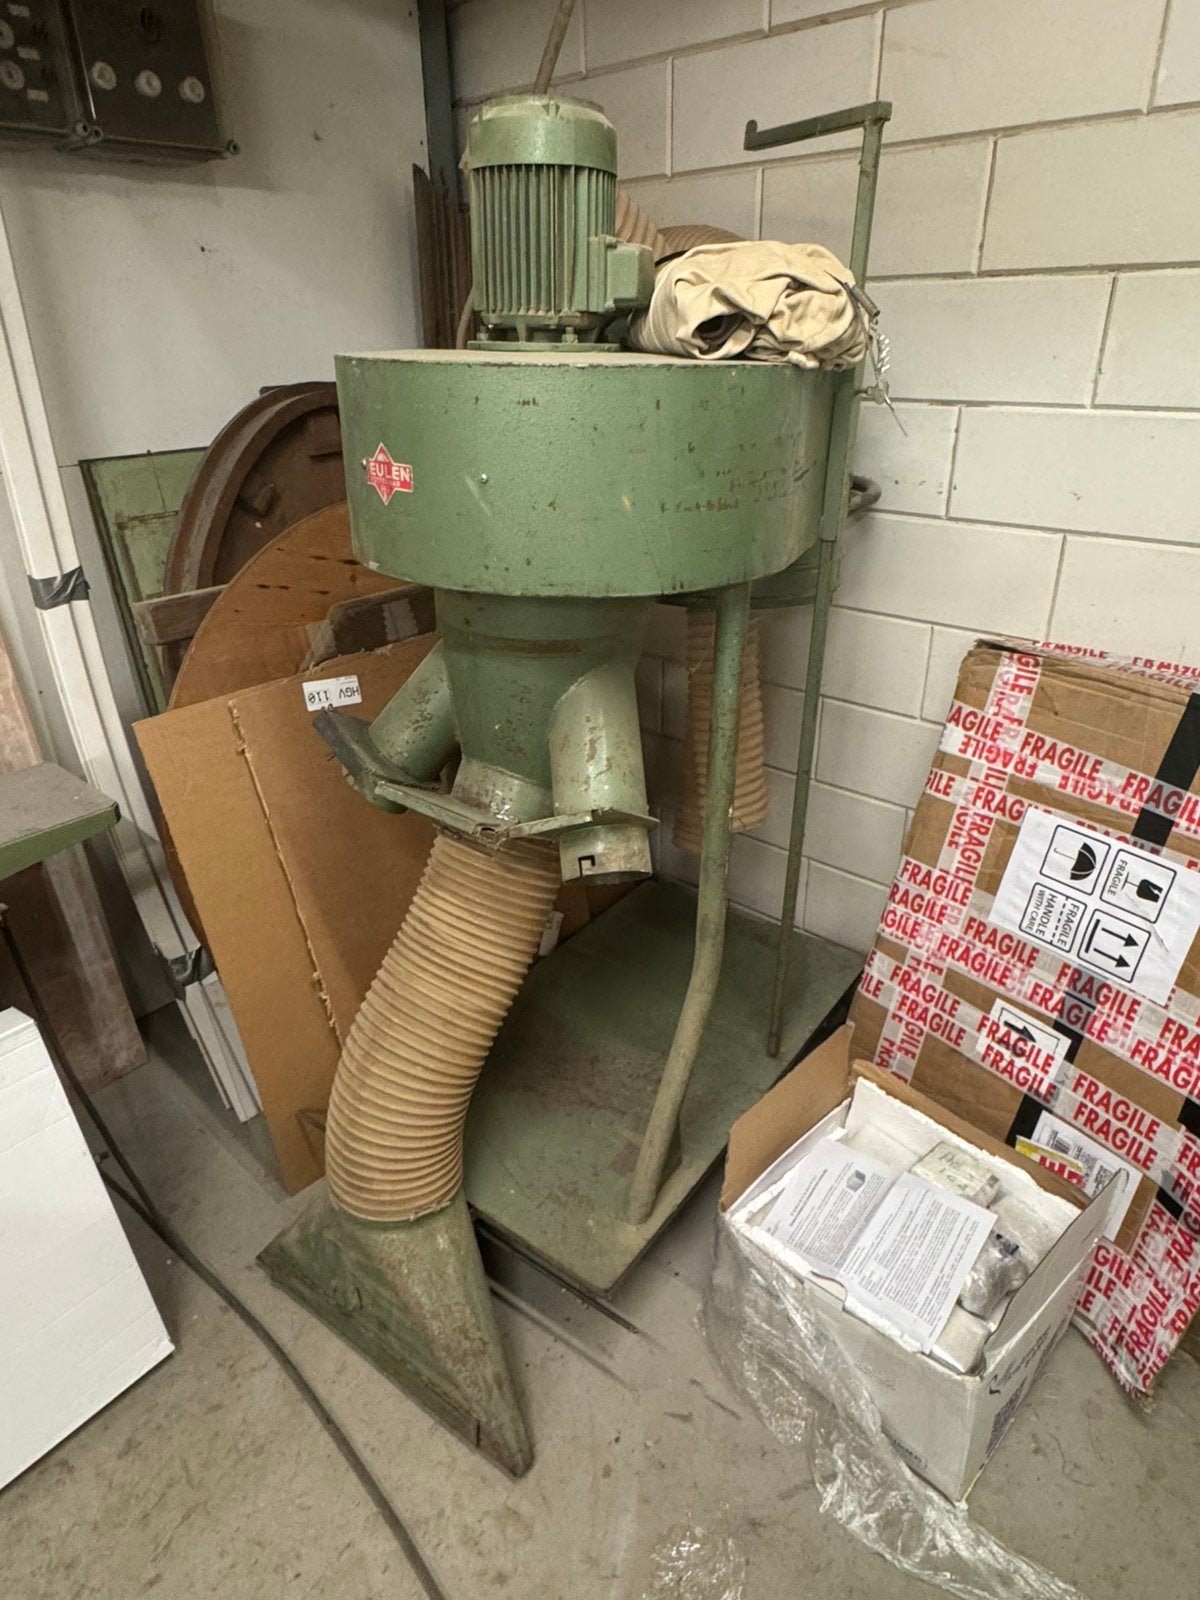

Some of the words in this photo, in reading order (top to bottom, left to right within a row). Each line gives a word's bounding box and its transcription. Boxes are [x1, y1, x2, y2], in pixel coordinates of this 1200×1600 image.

[369, 462, 410, 482] EULEN
[338, 686, 360, 699] HGV
[946, 702, 1003, 743] AGILE
[1020, 731, 1104, 782] FRAGILE
[1121, 772, 1200, 827] FRAGIL
[958, 734, 1038, 778] FRAGILE
[900, 859, 973, 907] FRAGILE
[1107, 859, 1128, 896] FRAGILE
[1025, 910, 1038, 931] CARE
[1035, 889, 1046, 911] WITH
[1035, 893, 1058, 937] HANDLE
[1057, 903, 1080, 947] FRAGILE
[963, 916, 1039, 969] FRAGILE
[1056, 962, 1142, 1022] FRAGILE
[881, 909, 921, 941] GILE
[937, 934, 1011, 987] FRAGILE
[1028, 982, 1112, 1043] FRAGILE
[1130, 1039, 1200, 1100] FRAGI
[860, 972, 884, 998] ILE
[897, 994, 966, 1047] FRAGILE
[981, 1044, 1057, 1104] FRAGILE
[1073, 1101, 1158, 1171] FRAGILE
[889, 964, 961, 1019] FRAGILE
[977, 1014, 1055, 1076] FRAGILE
[1072, 1073, 1161, 1143] FRAGILE
[1124, 1279, 1172, 1363] FRAGILE
